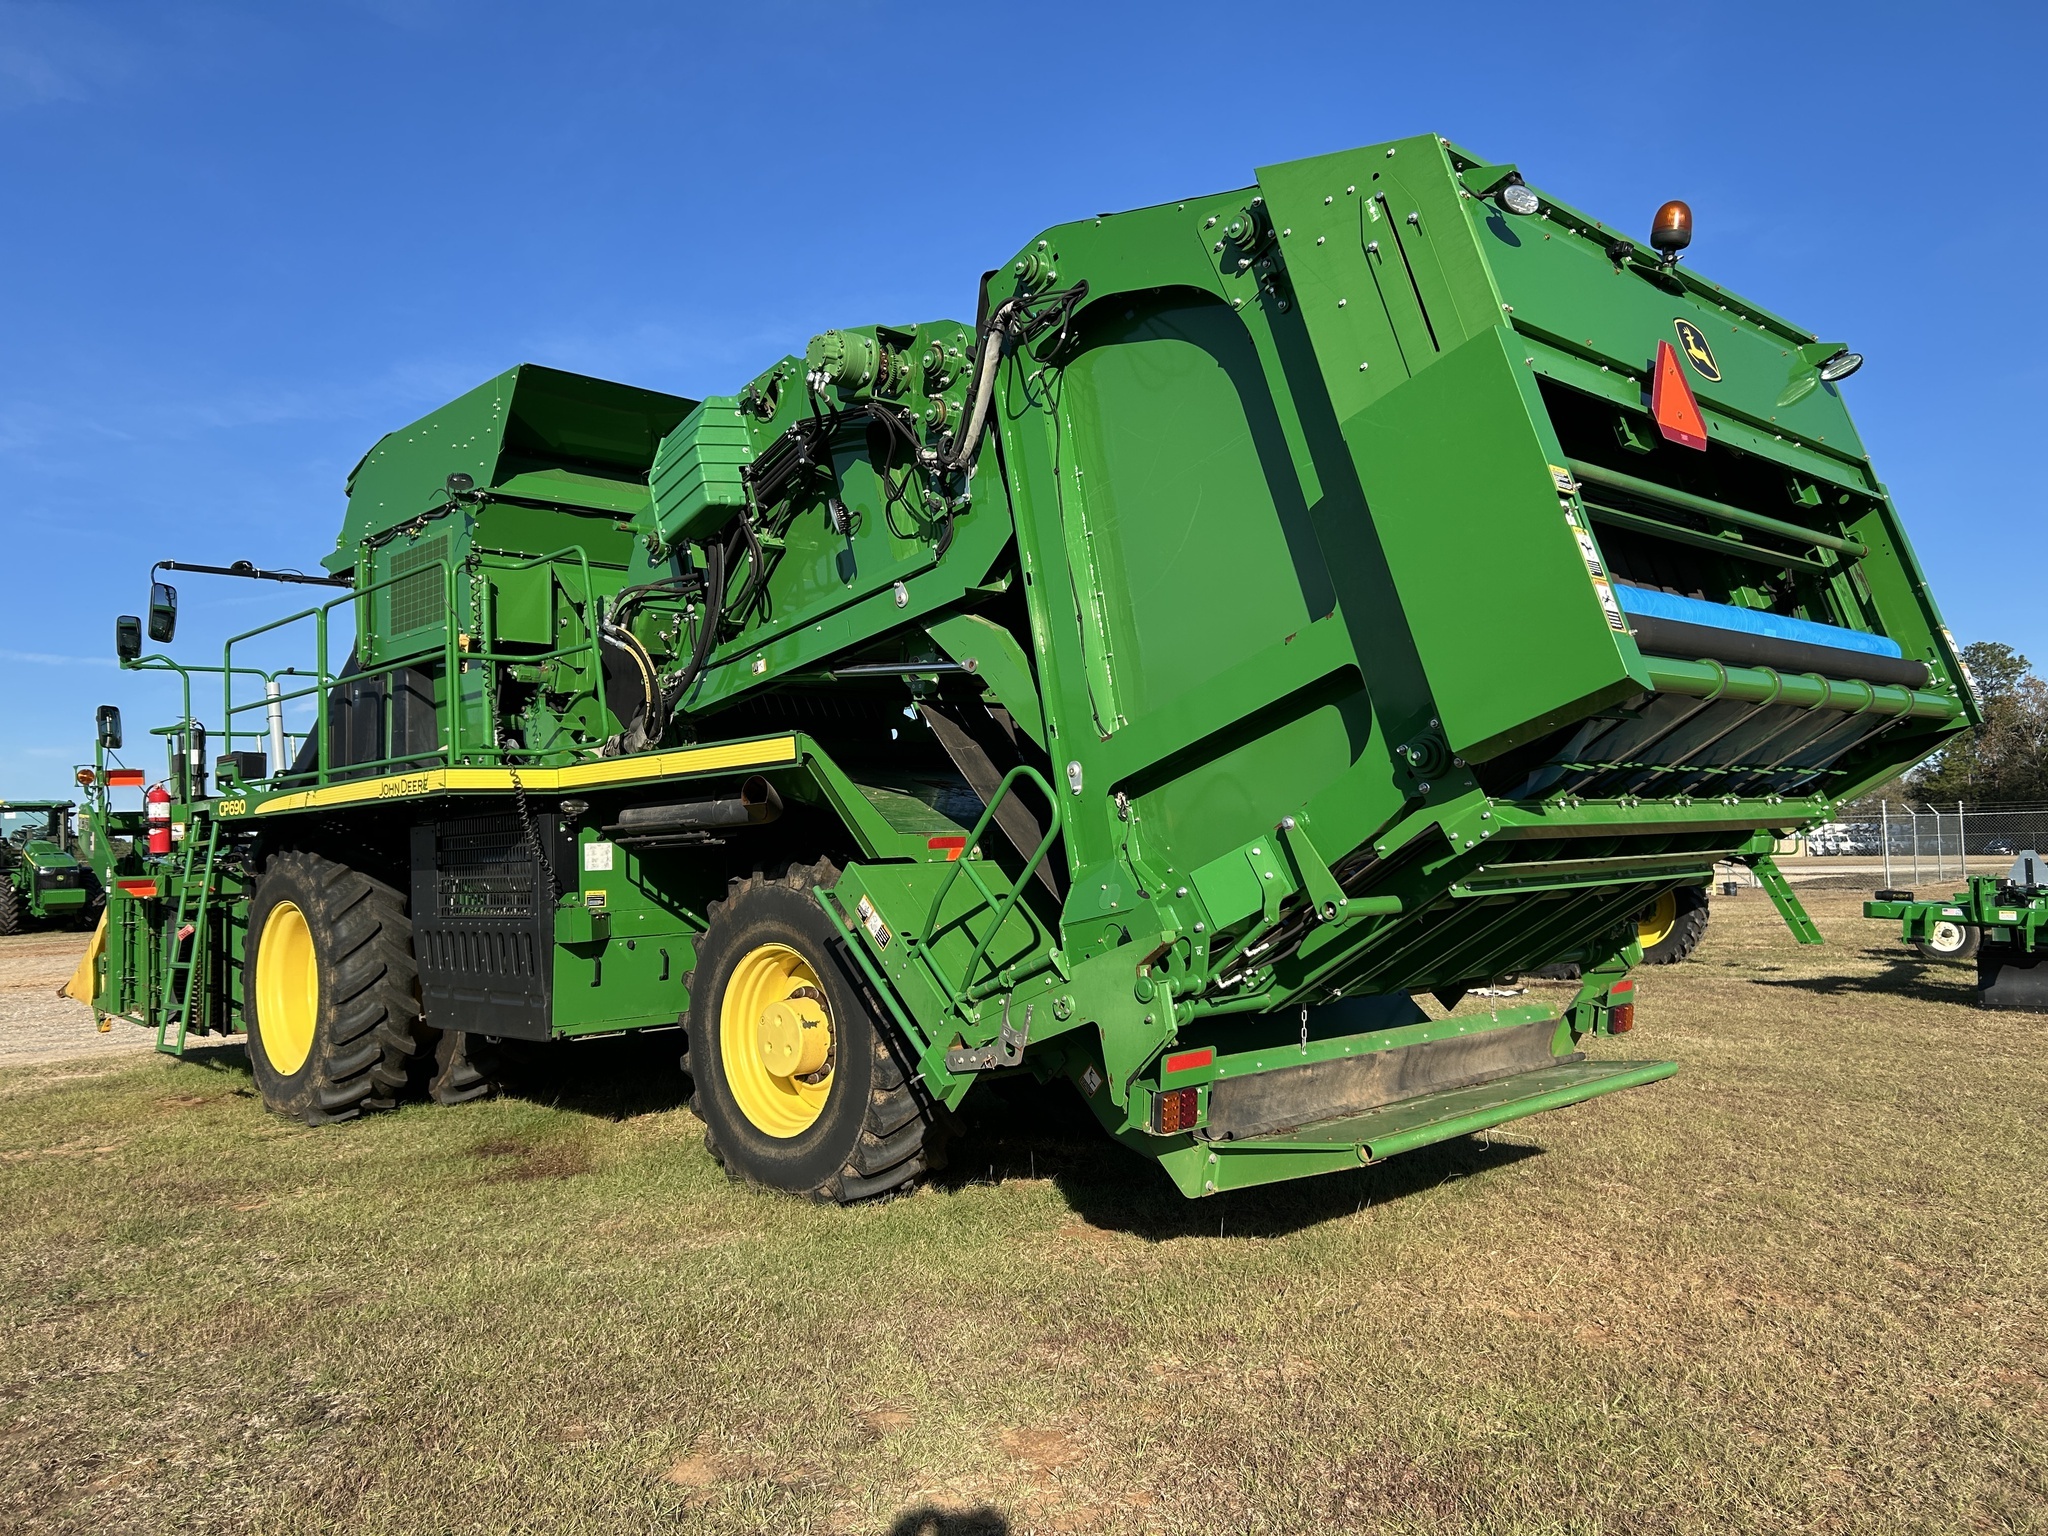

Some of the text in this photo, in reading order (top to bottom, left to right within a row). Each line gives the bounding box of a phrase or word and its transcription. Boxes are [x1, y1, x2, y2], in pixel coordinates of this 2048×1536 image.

[379, 779, 429, 797] JOHN DEERE
[219, 799, 246, 816] CP690
